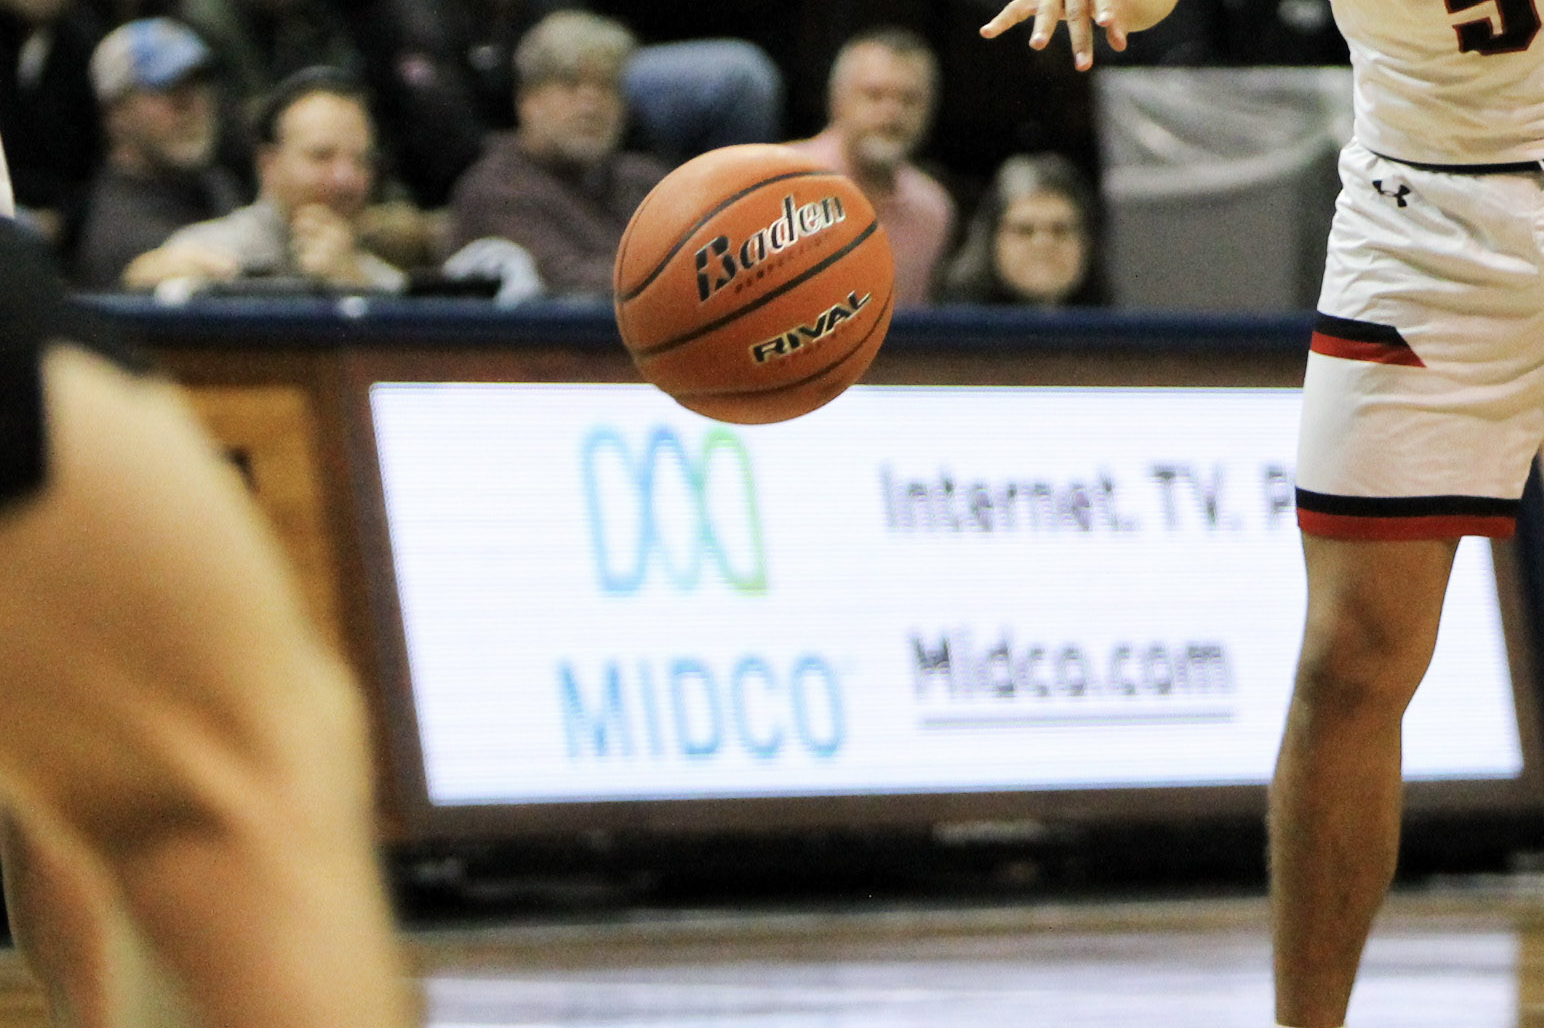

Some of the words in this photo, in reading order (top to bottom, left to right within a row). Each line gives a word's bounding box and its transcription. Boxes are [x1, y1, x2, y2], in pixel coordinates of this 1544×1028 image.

[693, 193, 847, 303] Baden
[749, 289, 872, 365] RIVAL
[556, 654, 846, 762] MIDCO
[909, 627, 1237, 702] Midco.com
